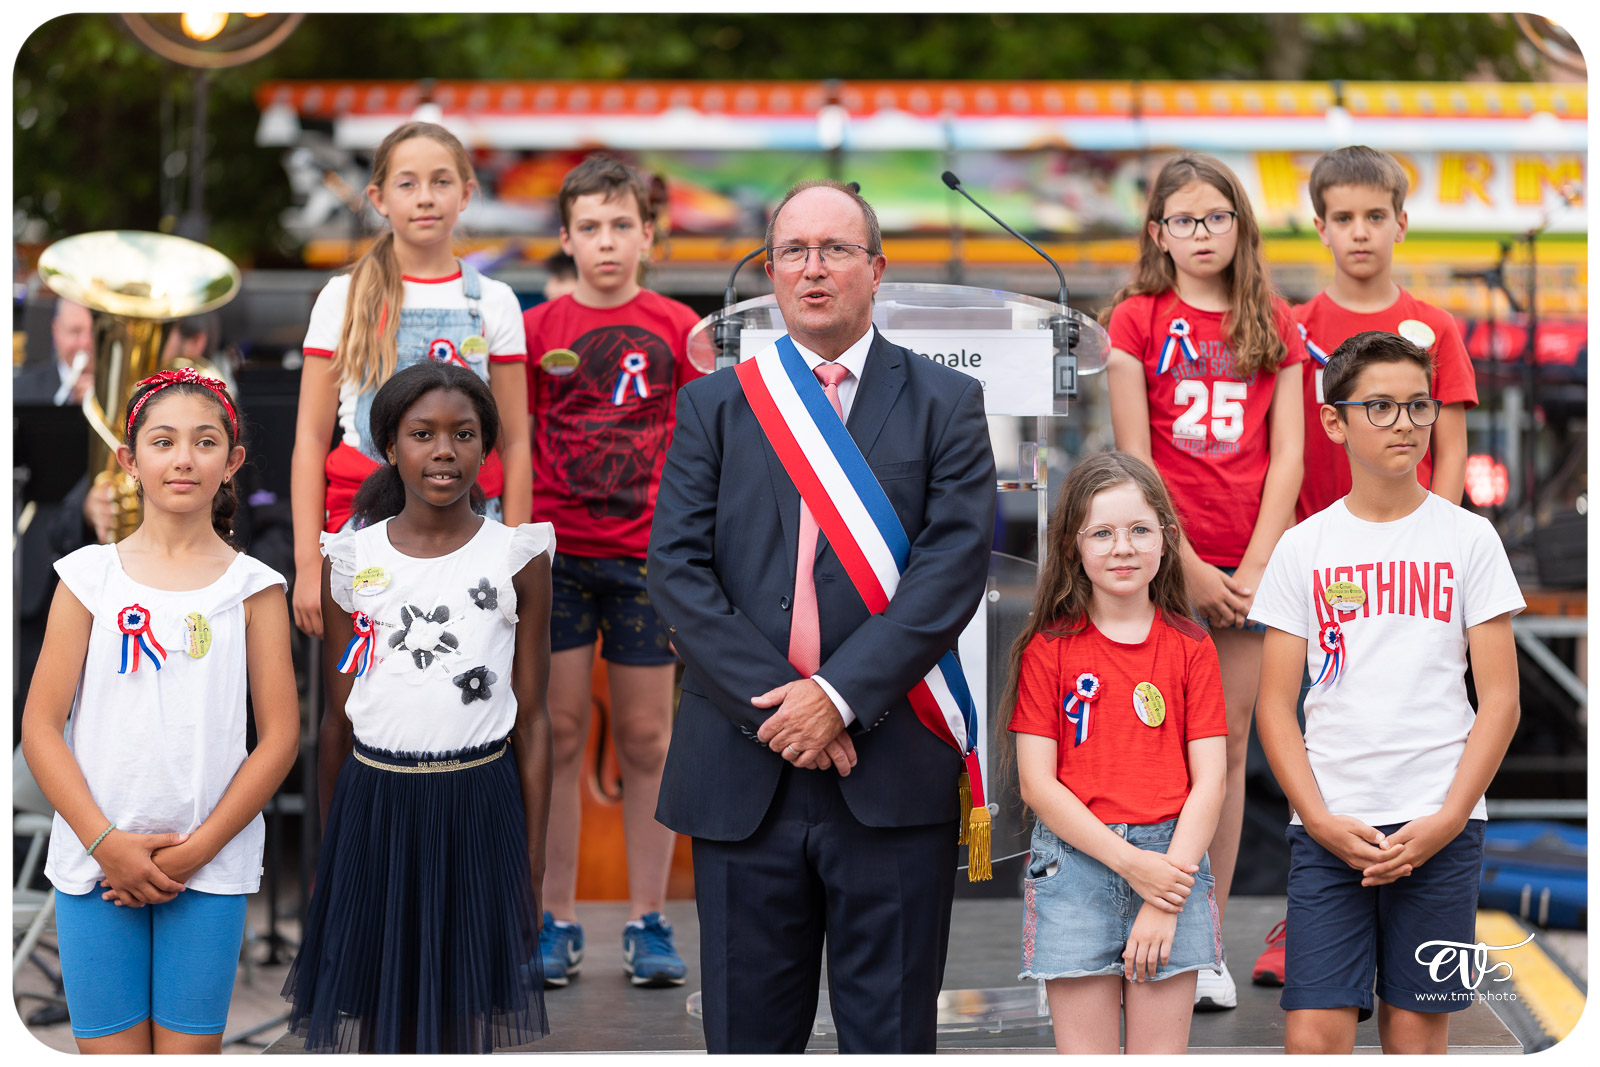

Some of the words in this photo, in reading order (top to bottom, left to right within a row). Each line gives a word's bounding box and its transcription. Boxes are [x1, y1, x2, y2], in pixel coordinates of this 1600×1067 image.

[1255, 150, 1583, 212] FRM
[909, 349, 982, 368] nale
[1211, 359, 1258, 387] SPOS
[1172, 379, 1248, 443] 25
[1208, 442, 1240, 454] LEAGUE
